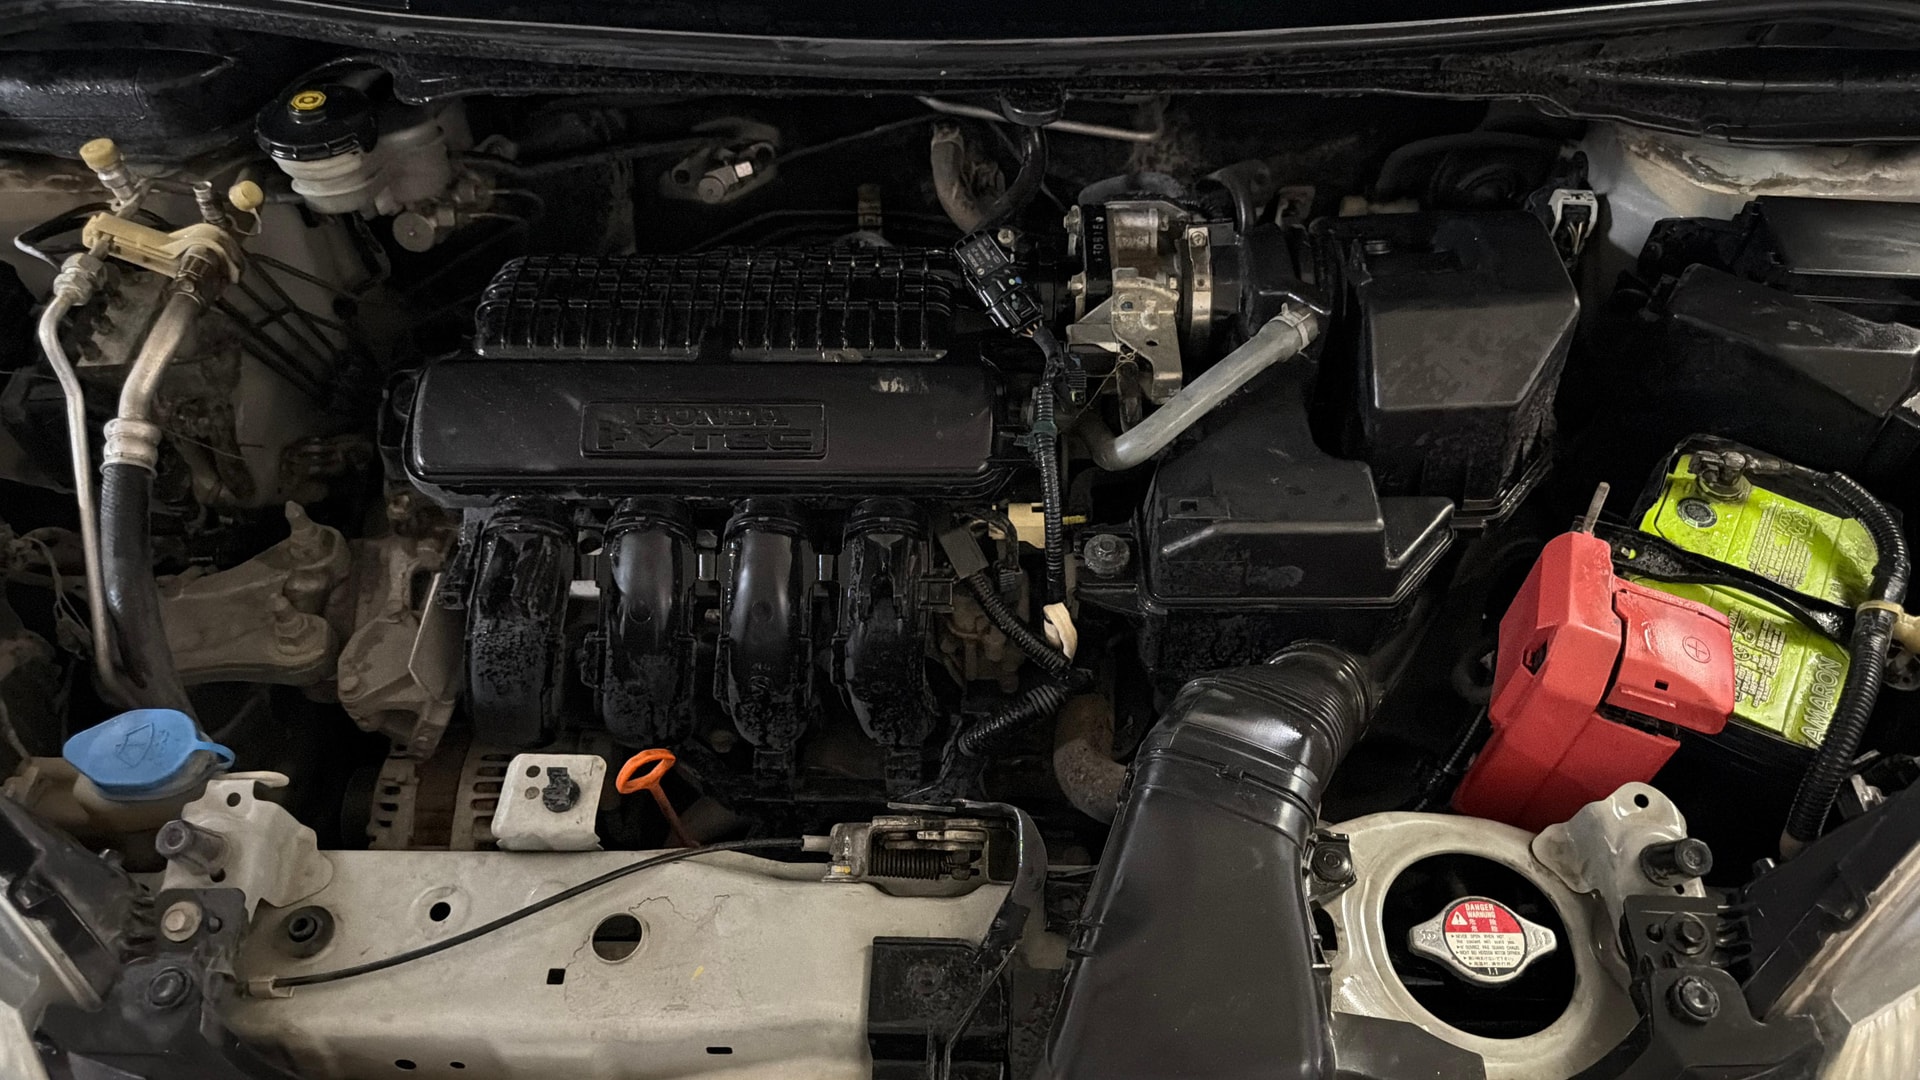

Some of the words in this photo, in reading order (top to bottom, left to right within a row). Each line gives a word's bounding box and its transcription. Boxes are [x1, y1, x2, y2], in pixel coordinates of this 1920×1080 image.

[635, 406, 790, 428] HONDA
[1801, 656, 1842, 745] AMARON
[1465, 903, 1494, 911] DANGER
[1488, 967, 1498, 975] 1.1
